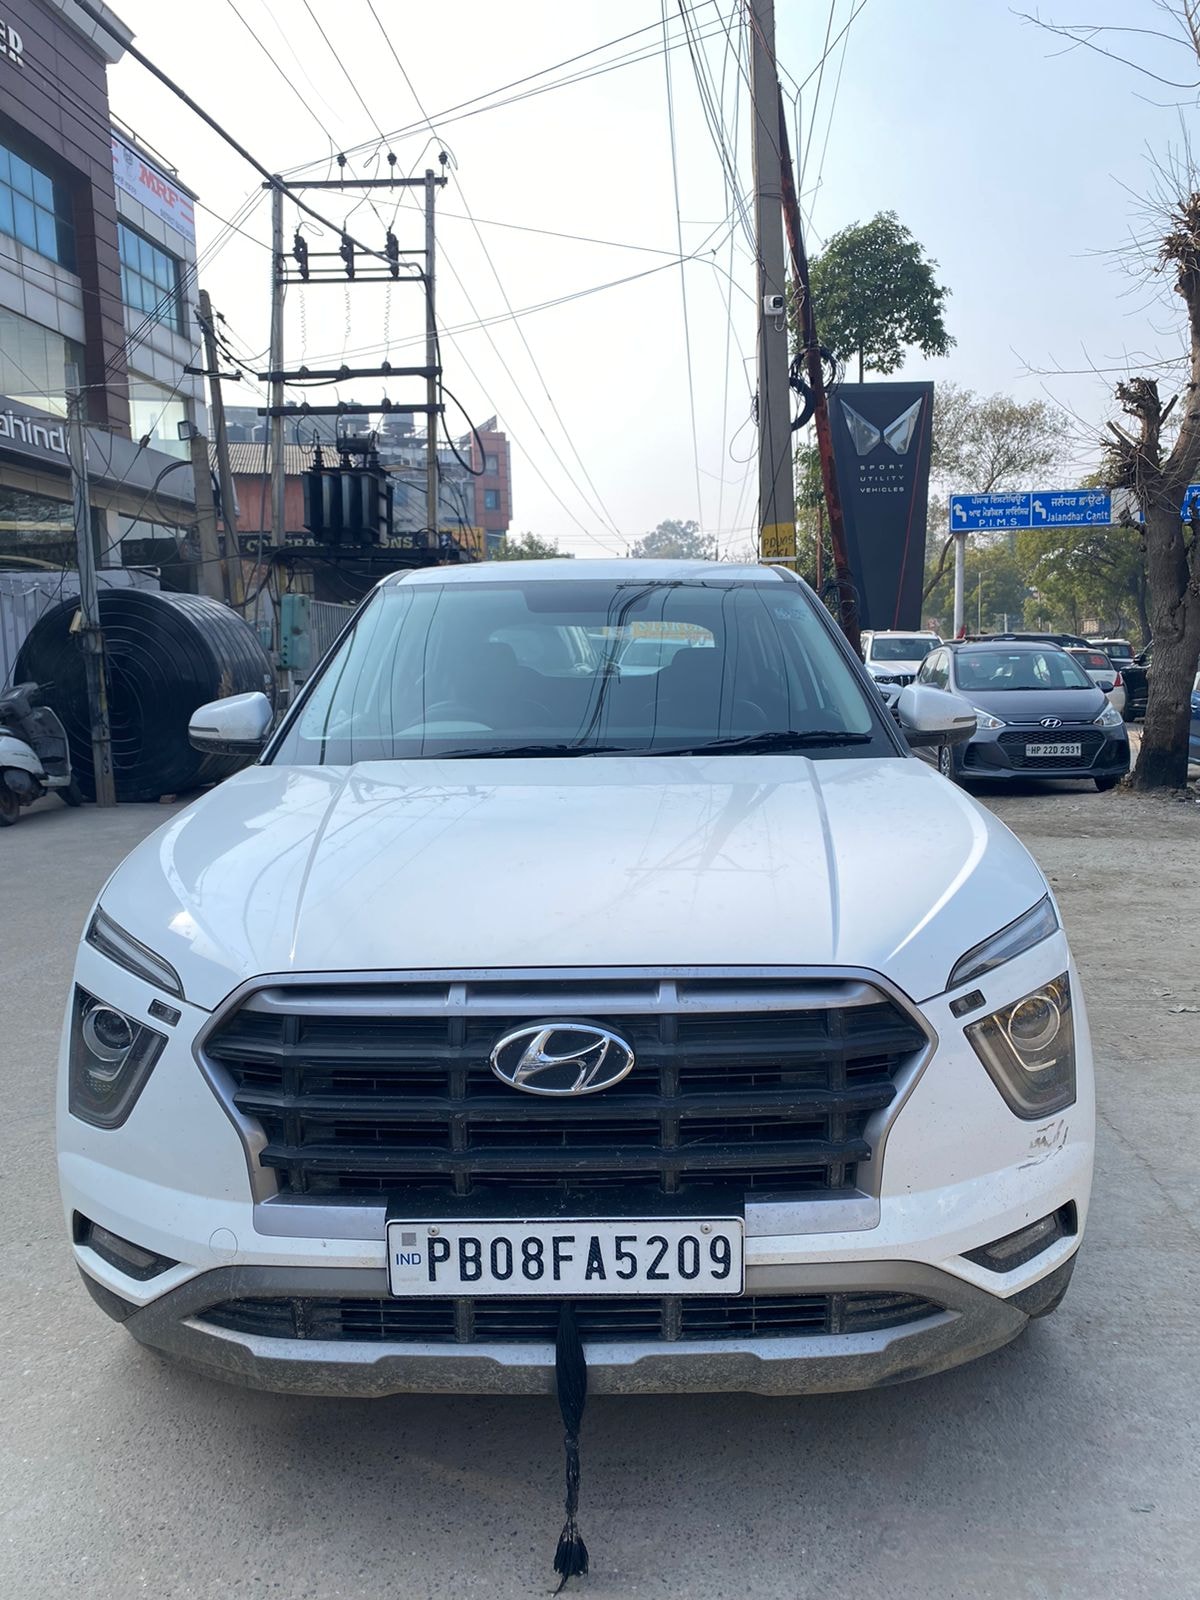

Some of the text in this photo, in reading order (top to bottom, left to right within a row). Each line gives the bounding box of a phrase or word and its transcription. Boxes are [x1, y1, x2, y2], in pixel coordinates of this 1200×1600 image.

[138, 161, 179, 209] MRF
[0, 409, 89, 461] ahind
[979, 518, 1021, 527] P.I.M.S.
[1047, 511, 1084, 522] Jalandhar
[1031, 746, 1041, 754] HP
[1060, 745, 1080, 754] 2931
[396, 1253, 422, 1265] IND
[427, 1235, 732, 1282] PB08FA5209
